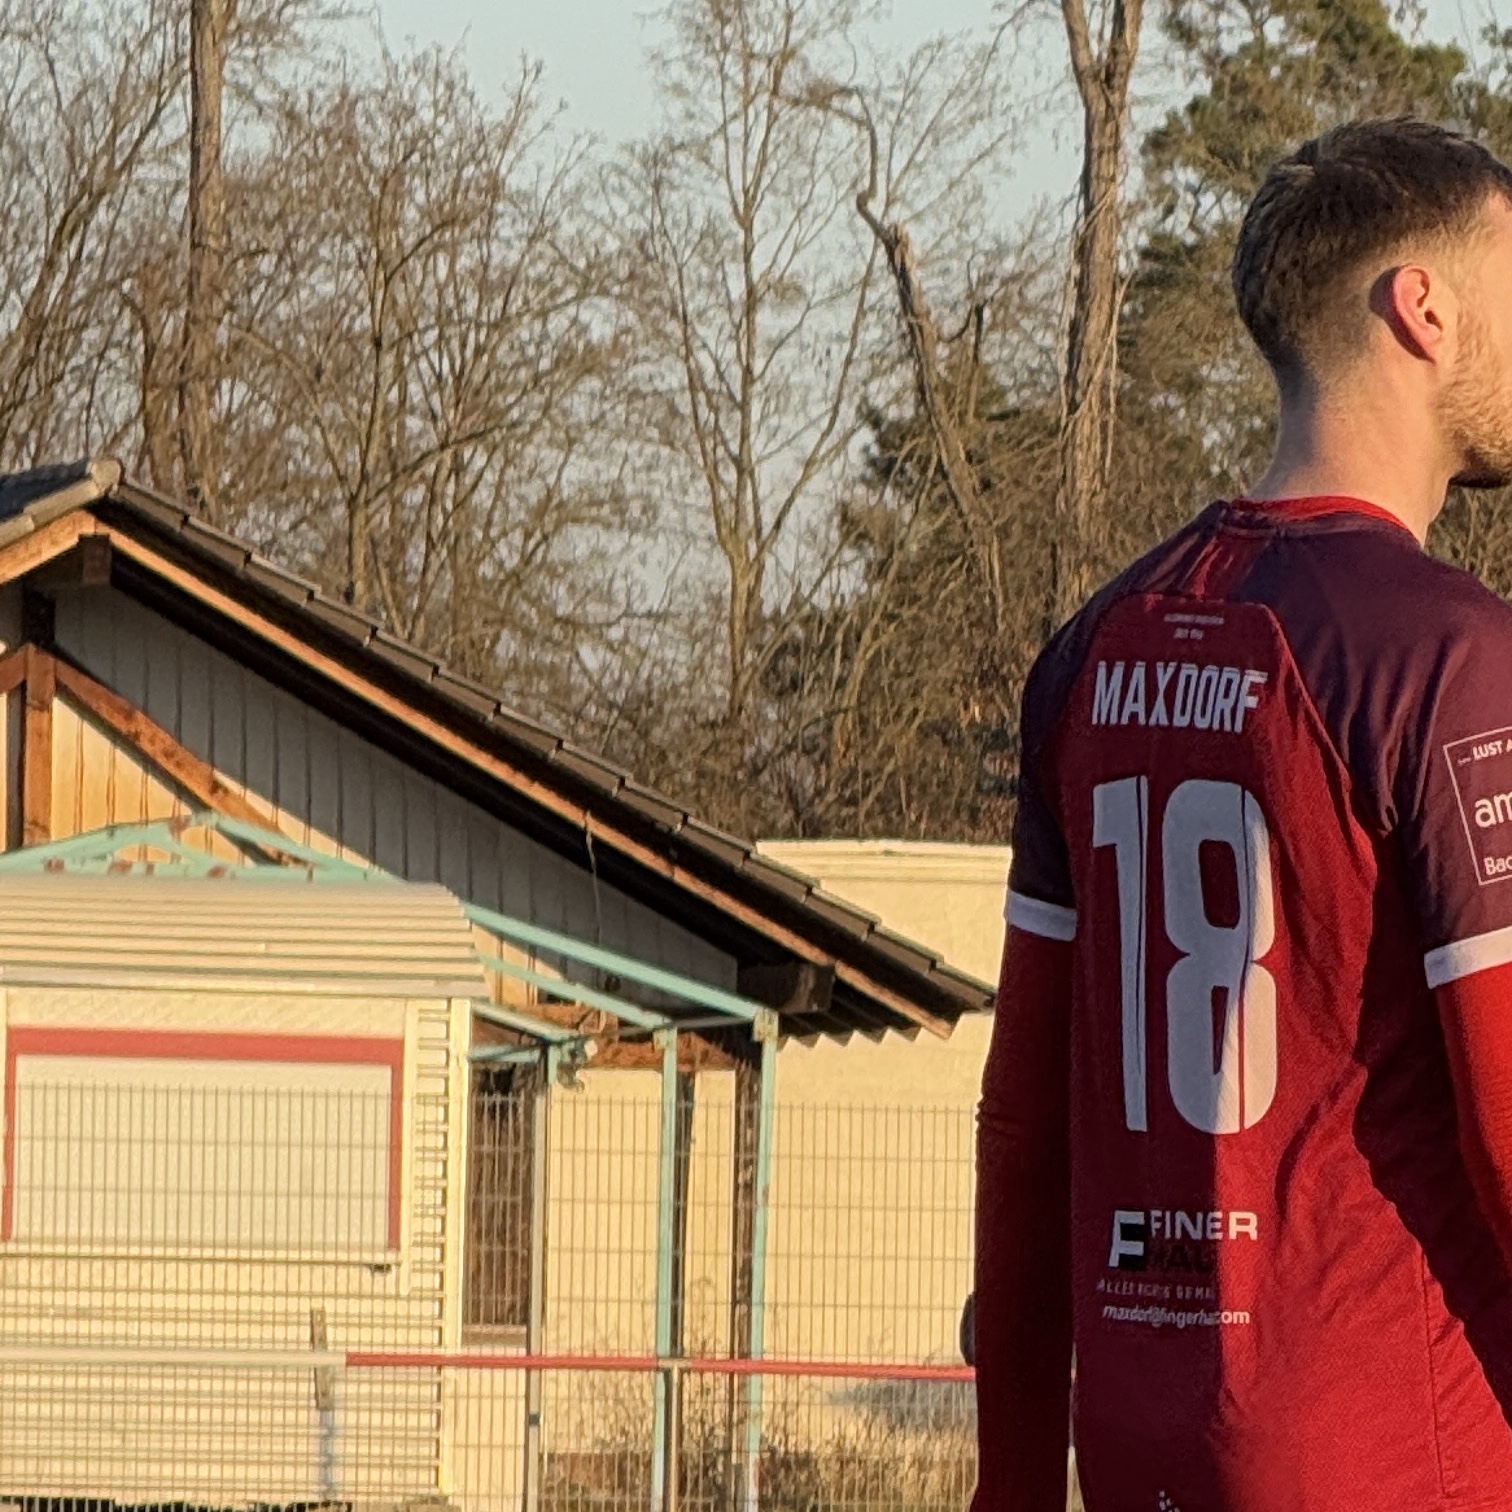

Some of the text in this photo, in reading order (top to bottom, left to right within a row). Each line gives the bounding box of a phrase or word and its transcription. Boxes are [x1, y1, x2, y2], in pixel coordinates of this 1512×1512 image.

[1092, 660, 1268, 733] MAXDORF
[1472, 740, 1503, 761] LUST
[1093, 775, 1278, 1134] 18
